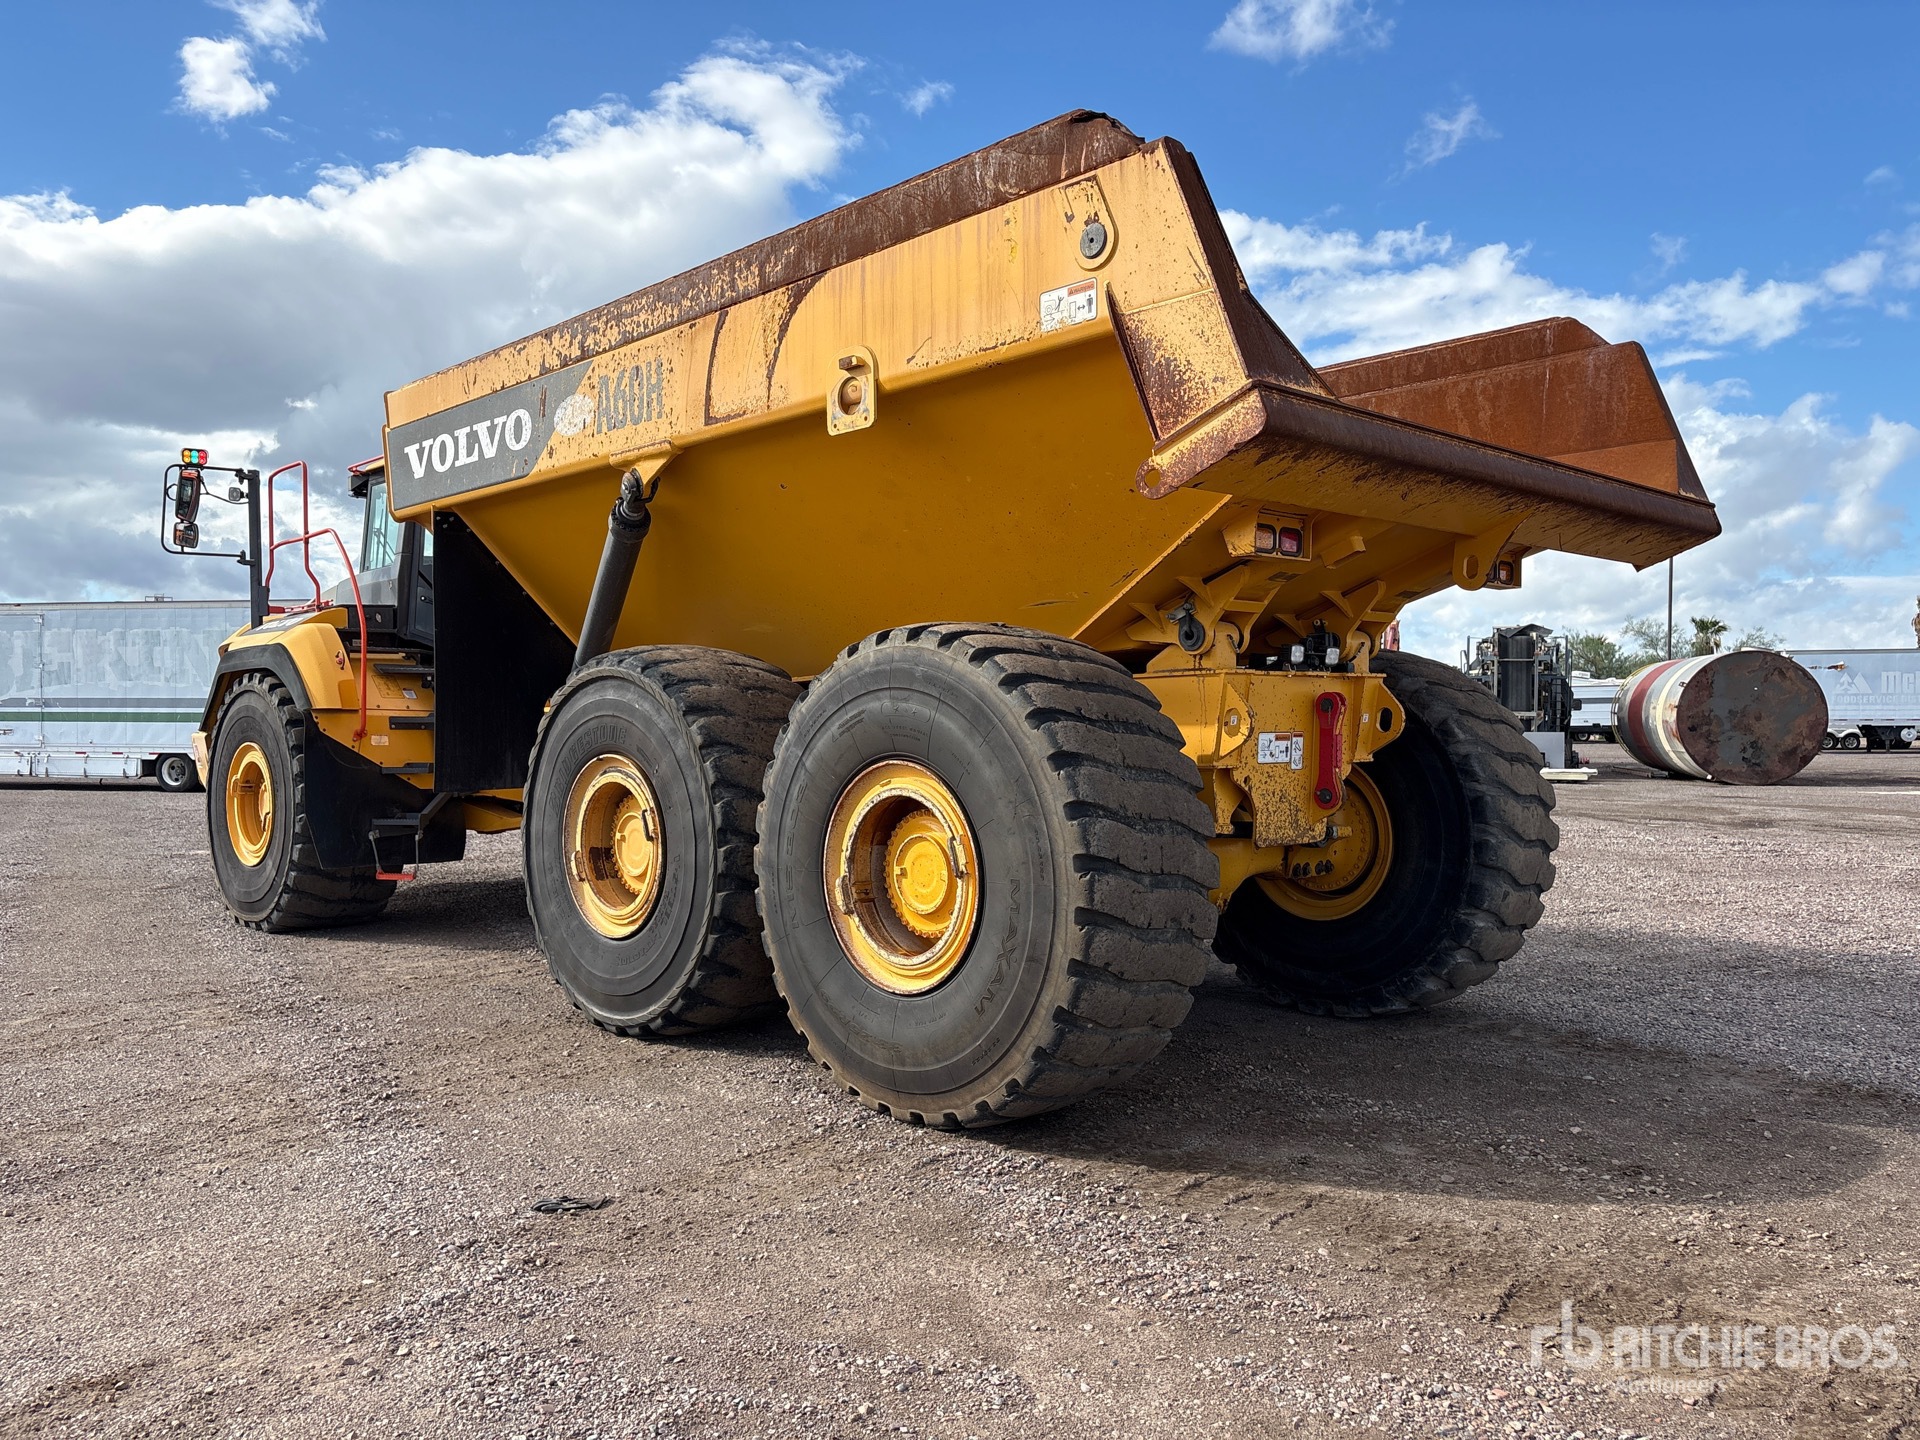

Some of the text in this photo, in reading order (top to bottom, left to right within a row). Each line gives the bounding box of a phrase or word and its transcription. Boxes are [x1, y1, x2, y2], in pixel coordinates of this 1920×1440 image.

[597, 357, 663, 434] A60H
[404, 408, 532, 479] VOLVO
[974, 878, 1021, 1017] MAXAM
